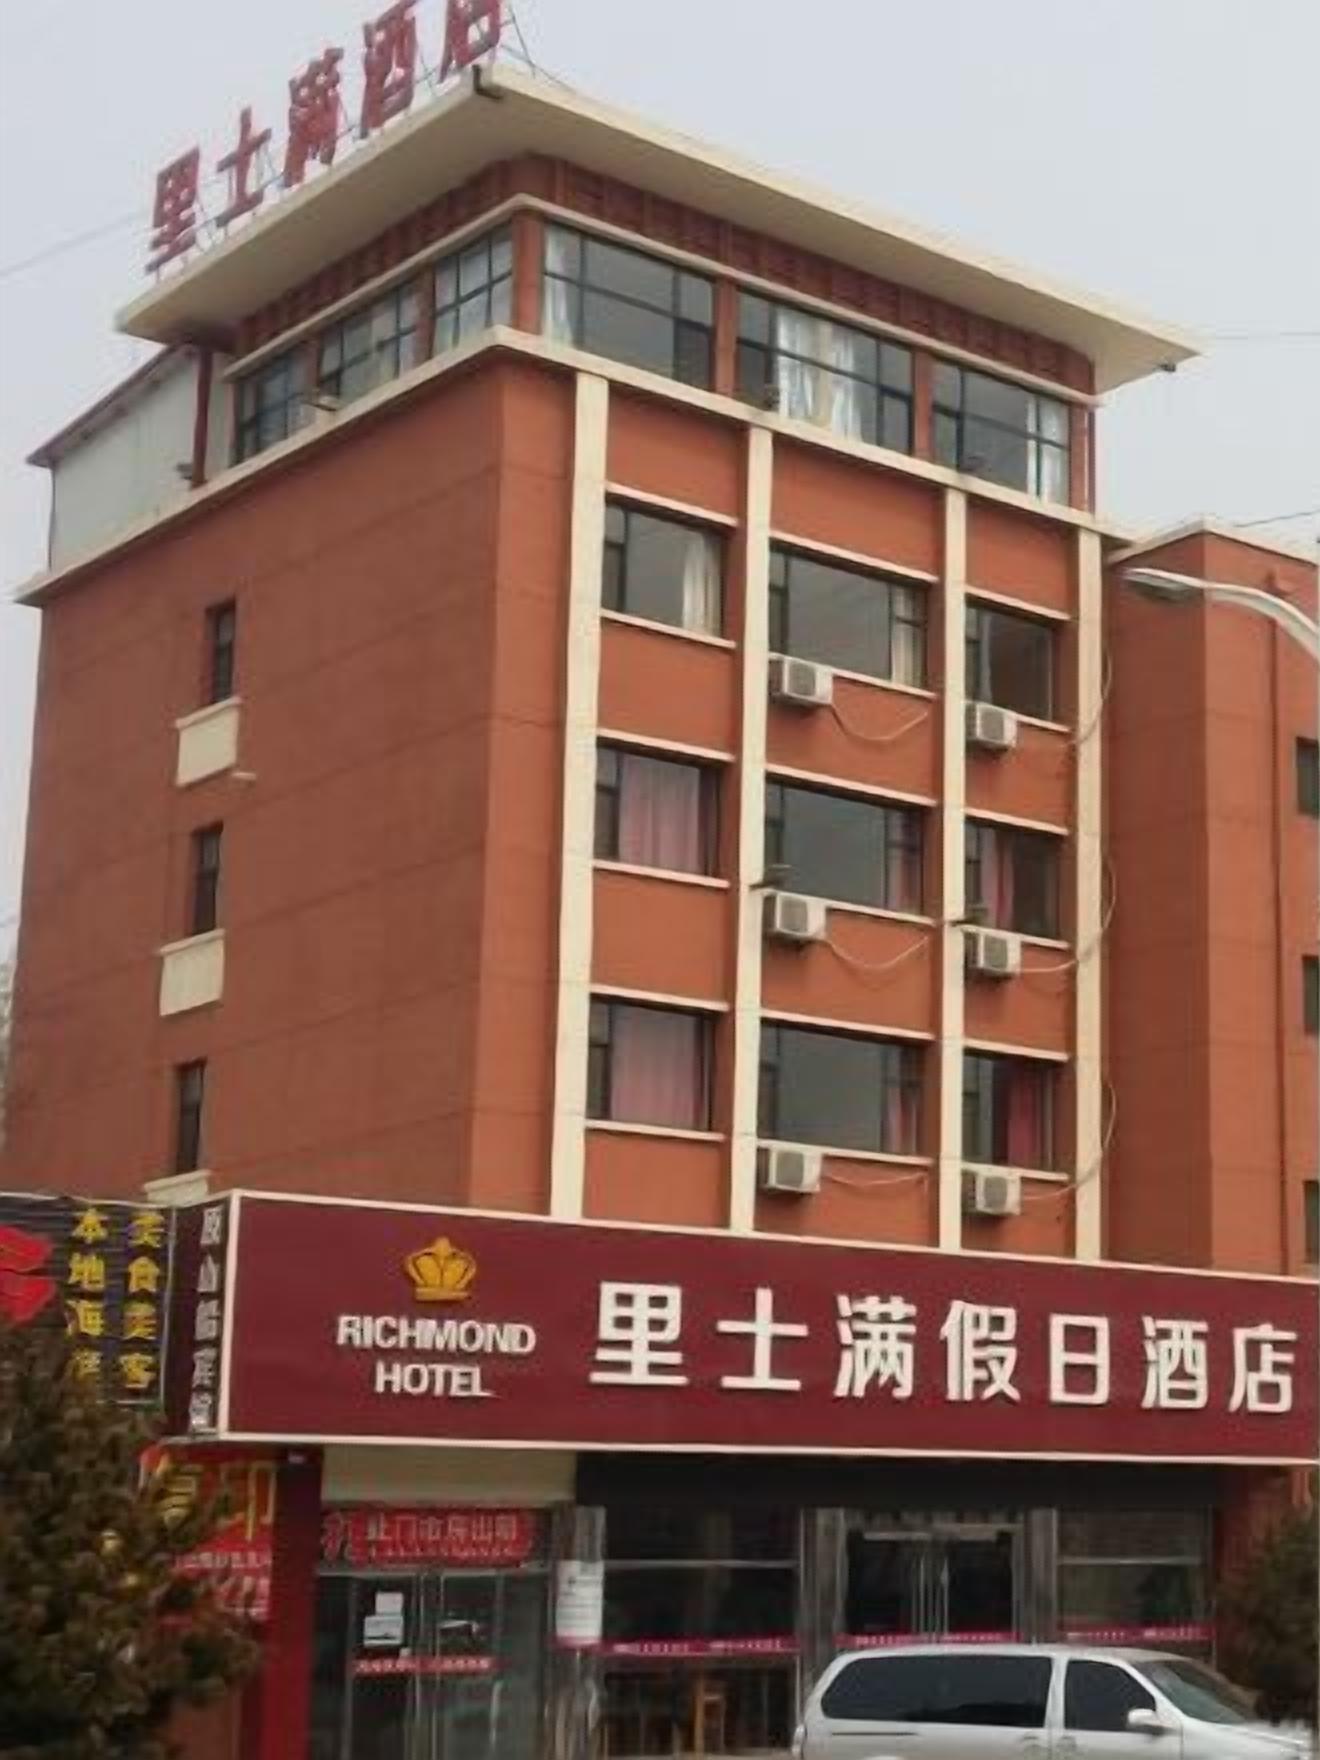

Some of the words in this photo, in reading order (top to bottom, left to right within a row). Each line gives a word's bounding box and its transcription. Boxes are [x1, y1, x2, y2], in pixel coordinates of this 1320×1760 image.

[336, 1314, 537, 1355] RICHMOND
[588, 1280, 1299, 1413] 里士满假日酒店
[374, 1360, 502, 1397] HOTEL
